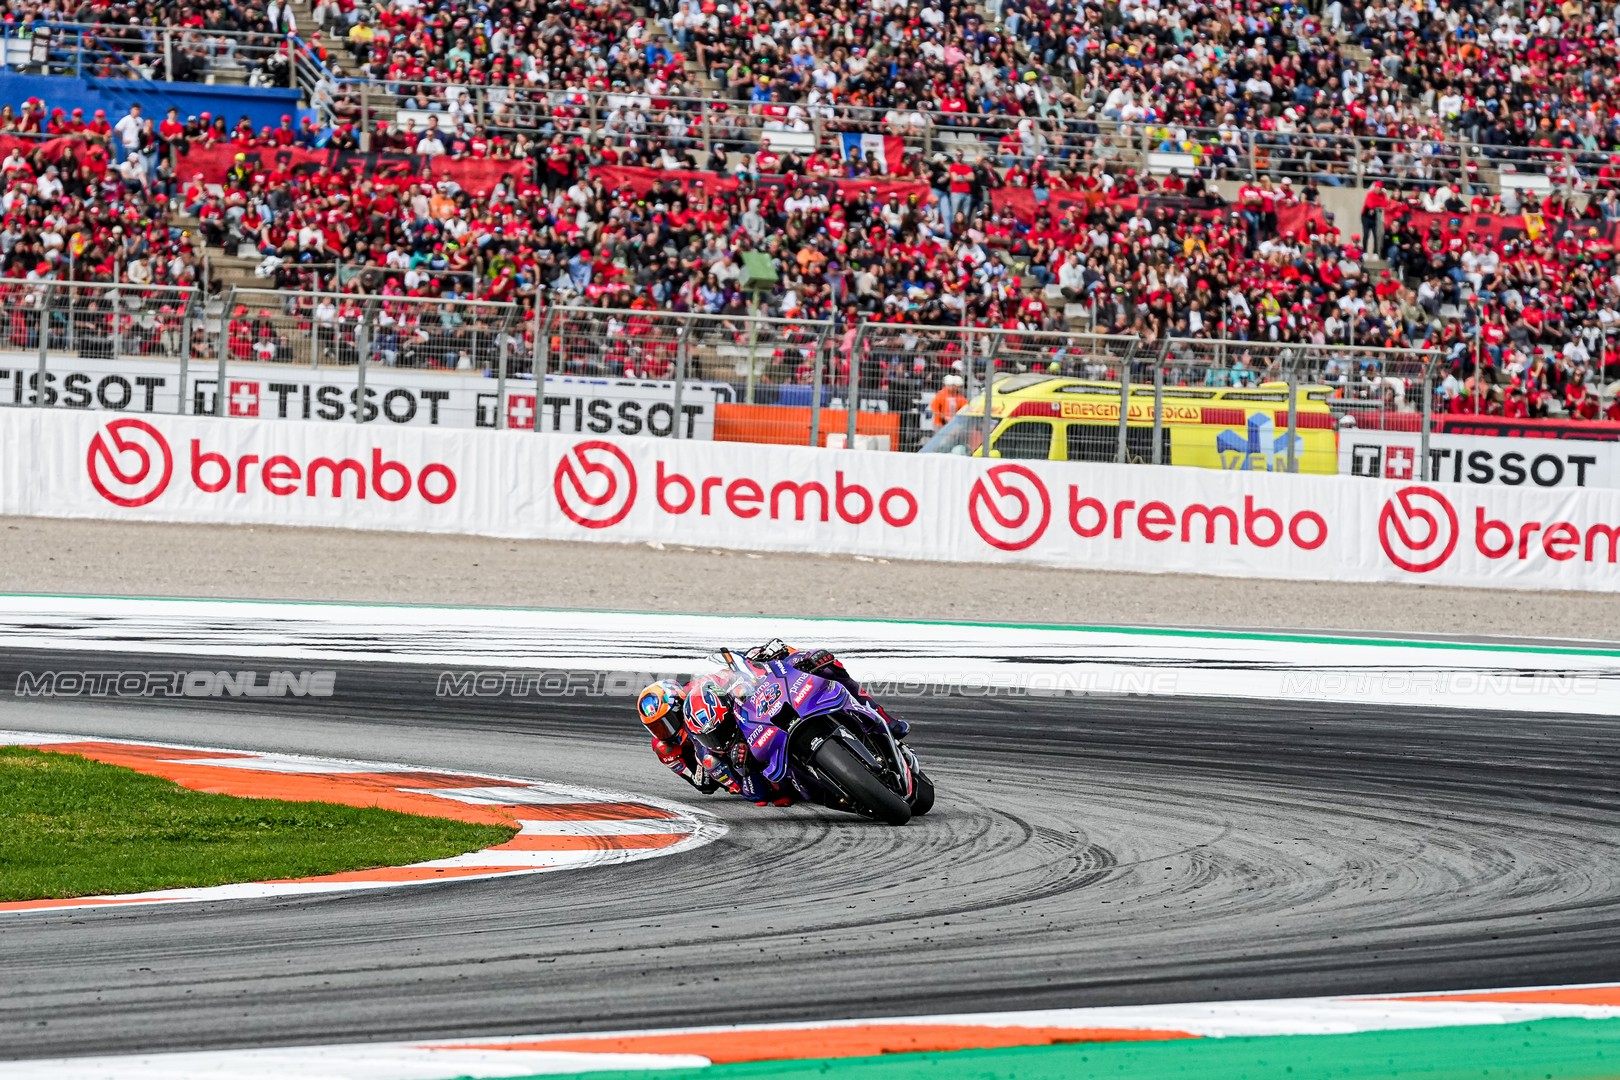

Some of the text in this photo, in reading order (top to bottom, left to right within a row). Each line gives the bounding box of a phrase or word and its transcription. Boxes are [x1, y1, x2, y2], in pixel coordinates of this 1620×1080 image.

[268, 383, 450, 425] TISSOT
[544, 397, 704, 439] TISSOT
[1064, 402, 1142, 418] EMERGENAS
[191, 439, 457, 504] brembo
[1430, 449, 1596, 487] TISSOT
[656, 460, 918, 527] brembo
[1069, 484, 1328, 550] brembo
[794, 684, 813, 704] MOTUL
[757, 728, 774, 747] MOTUL
